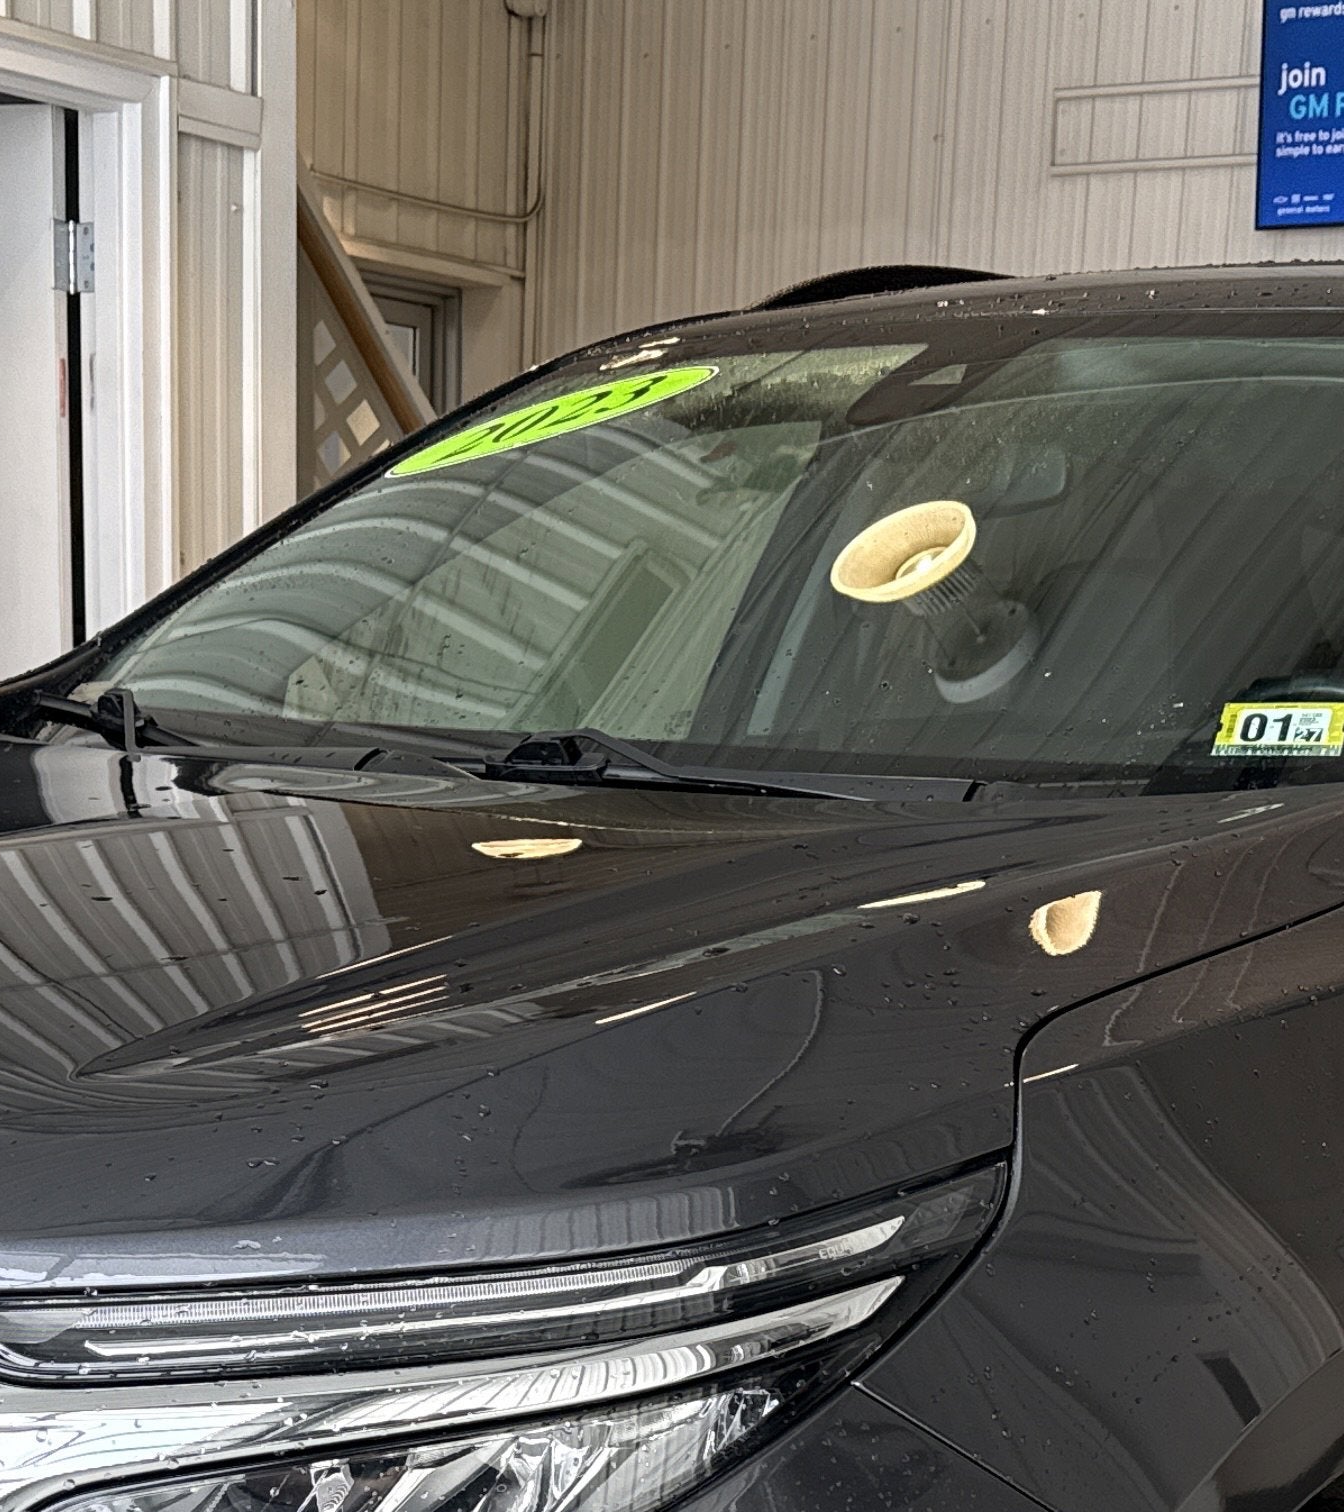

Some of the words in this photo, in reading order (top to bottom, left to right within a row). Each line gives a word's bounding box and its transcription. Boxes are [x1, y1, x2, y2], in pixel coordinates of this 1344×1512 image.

[1280, 8, 1296, 24] gm
[1277, 61, 1327, 96] join
[1289, 93, 1329, 120] GM
[430, 374, 669, 466] 2023
[1239, 712, 1294, 742] 01
